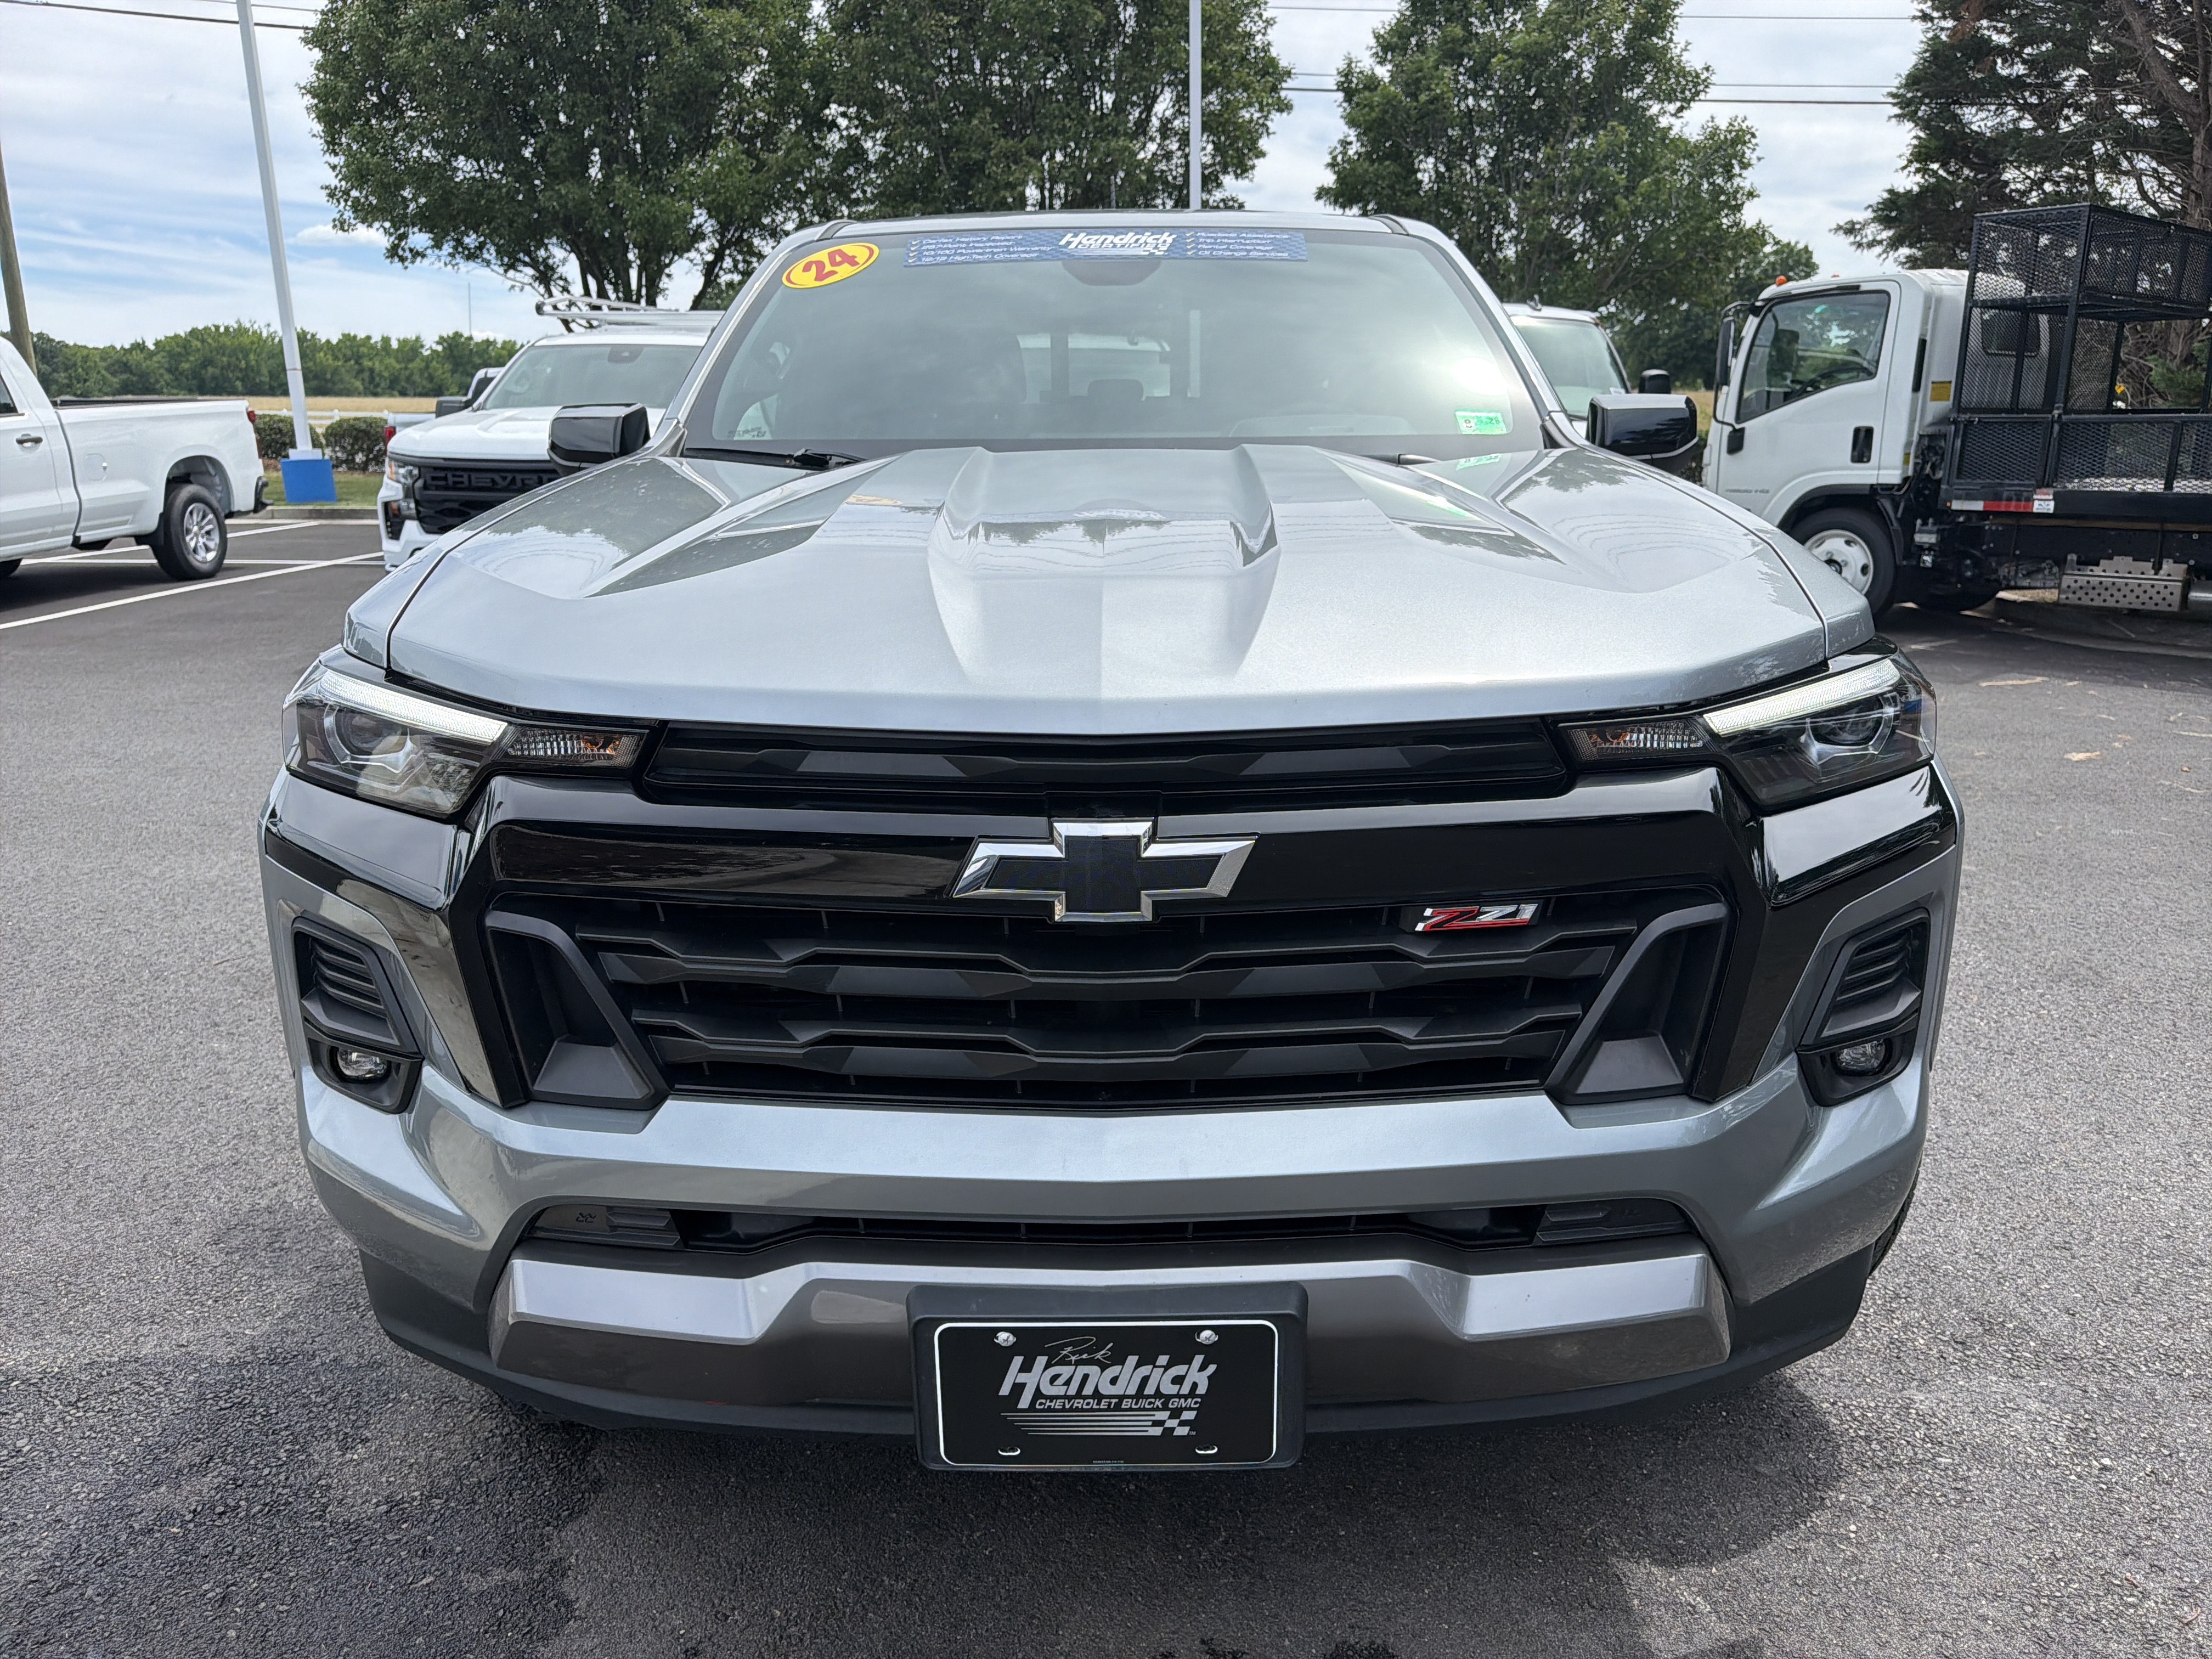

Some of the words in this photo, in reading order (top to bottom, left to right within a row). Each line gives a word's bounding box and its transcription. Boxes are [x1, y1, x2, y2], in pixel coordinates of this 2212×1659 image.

[1058, 232, 1177, 249] Hendrick
[802, 249, 860, 282] 24
[1414, 904, 1538, 932] Z71
[1044, 1336, 1114, 1364] Rick
[998, 1355, 1217, 1409] Hendrick
[1035, 1398, 1119, 1409] CHEVROLET
[1121, 1398, 1164, 1409] BUICK
[1167, 1398, 1201, 1408] GMC
